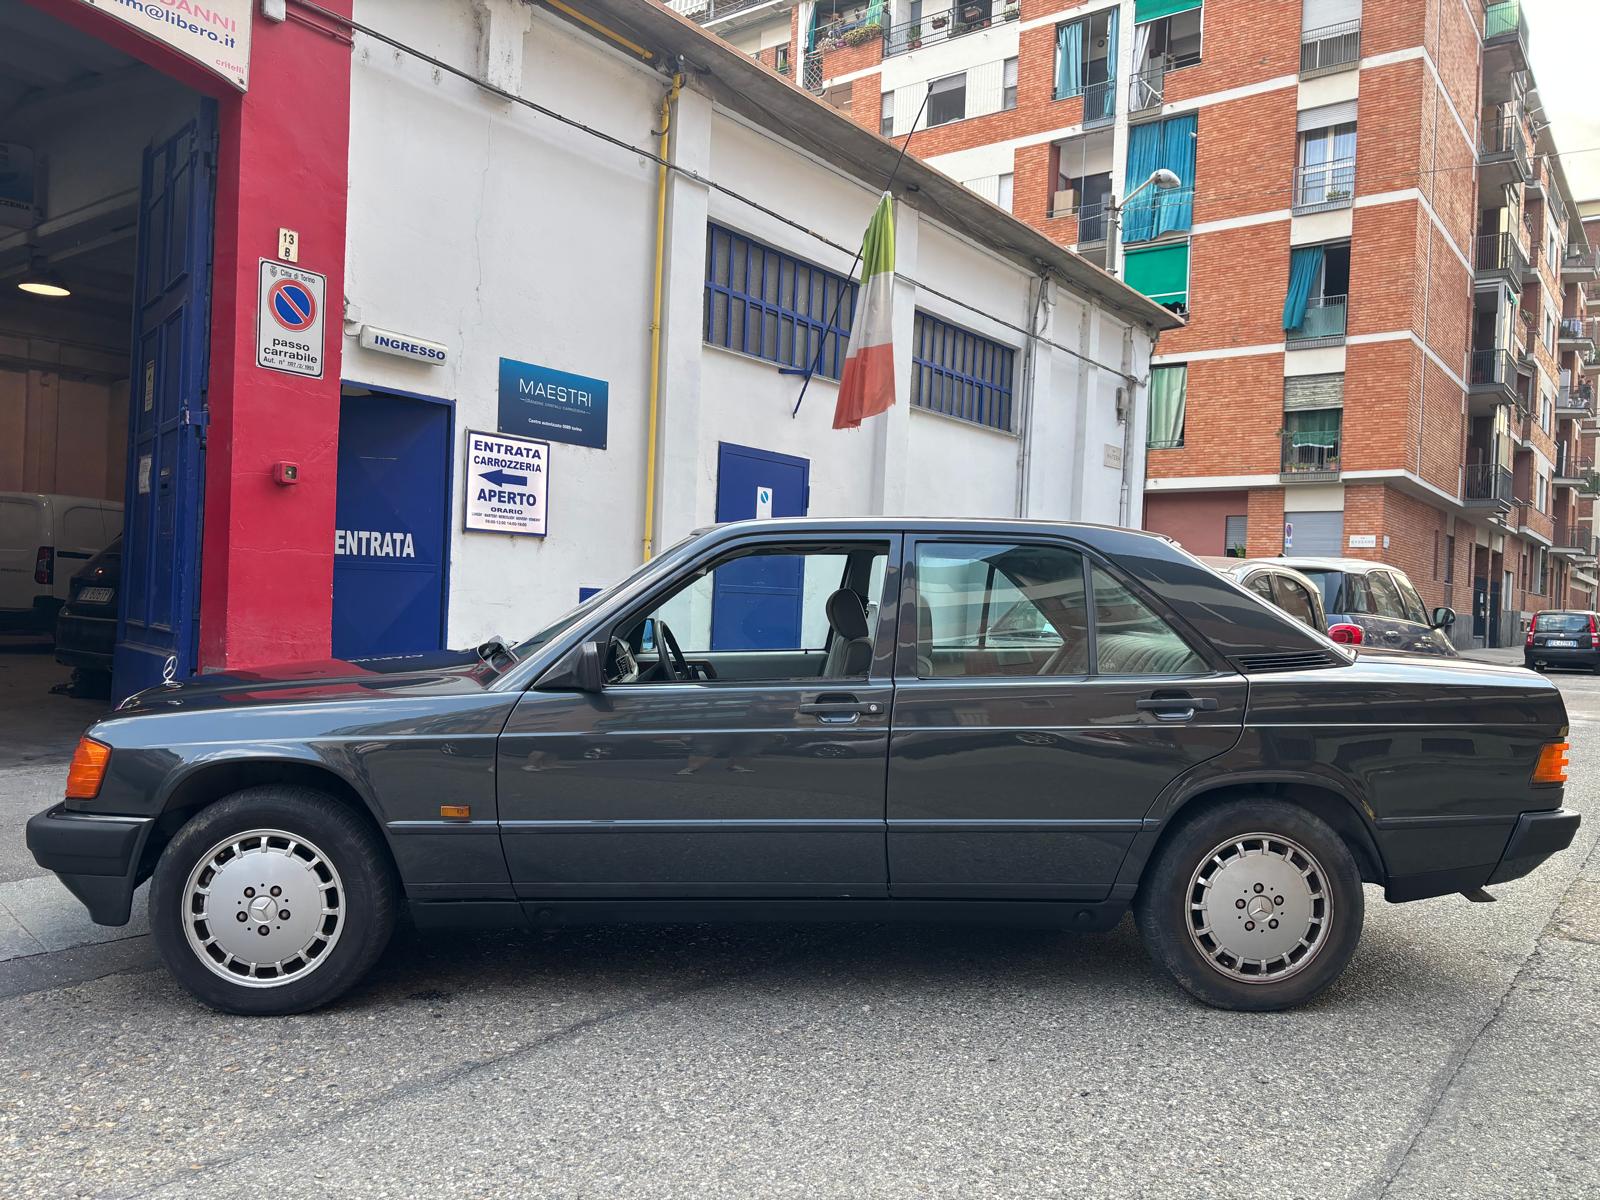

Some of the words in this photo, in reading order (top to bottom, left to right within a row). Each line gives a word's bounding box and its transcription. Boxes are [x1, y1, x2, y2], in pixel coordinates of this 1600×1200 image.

[216, 59, 244, 74] critelli
[283, 232, 295, 245] 13
[284, 247, 291, 257] B
[301, 273, 316, 284] Torino
[272, 338, 310, 352] passo
[374, 335, 446, 361] INGRESSO
[263, 346, 318, 364] carrabile
[263, 355, 276, 364] Aut.
[519, 378, 592, 408] MAESTRI
[474, 440, 542, 460] ENTRATA
[474, 455, 542, 473] CARROZZERIA
[477, 488, 537, 507] APERTO
[490, 507, 523, 515] ORARIO
[335, 529, 415, 557] ENTRATA
